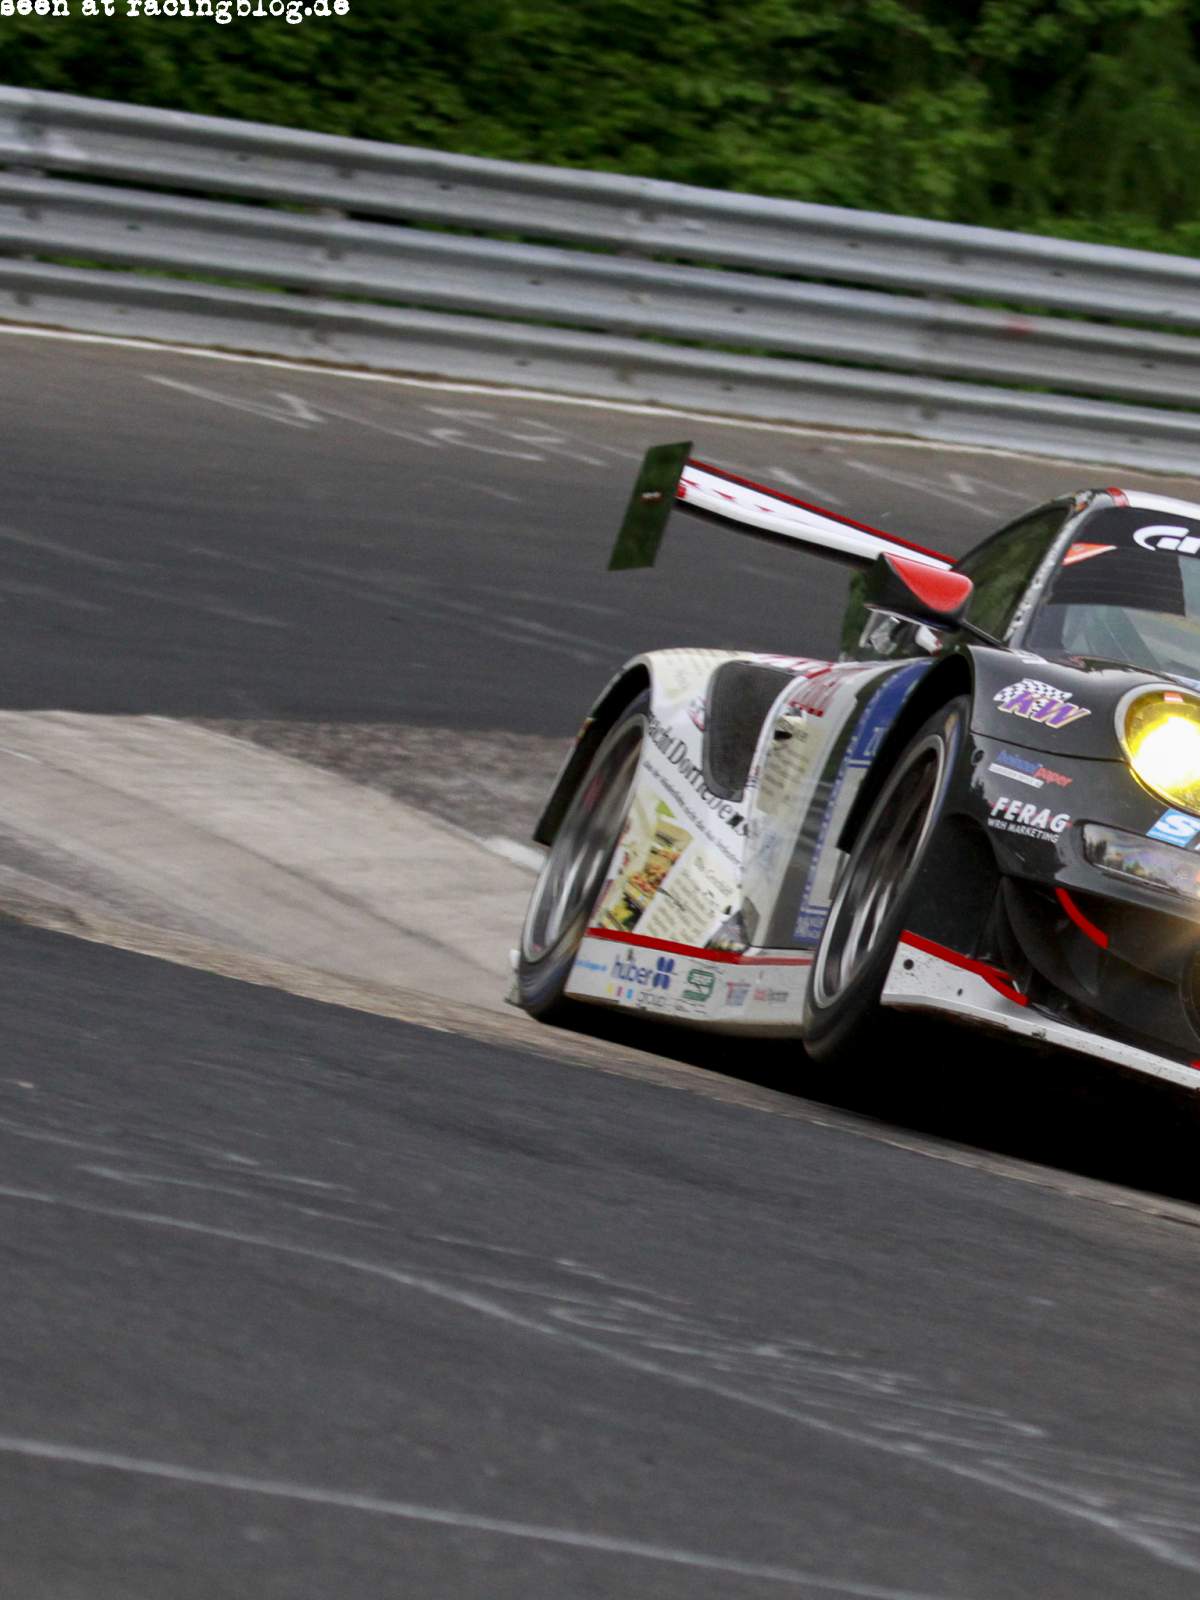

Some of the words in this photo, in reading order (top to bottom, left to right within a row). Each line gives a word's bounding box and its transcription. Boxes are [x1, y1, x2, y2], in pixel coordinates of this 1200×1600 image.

[997, 690, 1092, 729] KW
[990, 796, 1071, 833] FERAG
[1007, 822, 1060, 844] MARKETING
